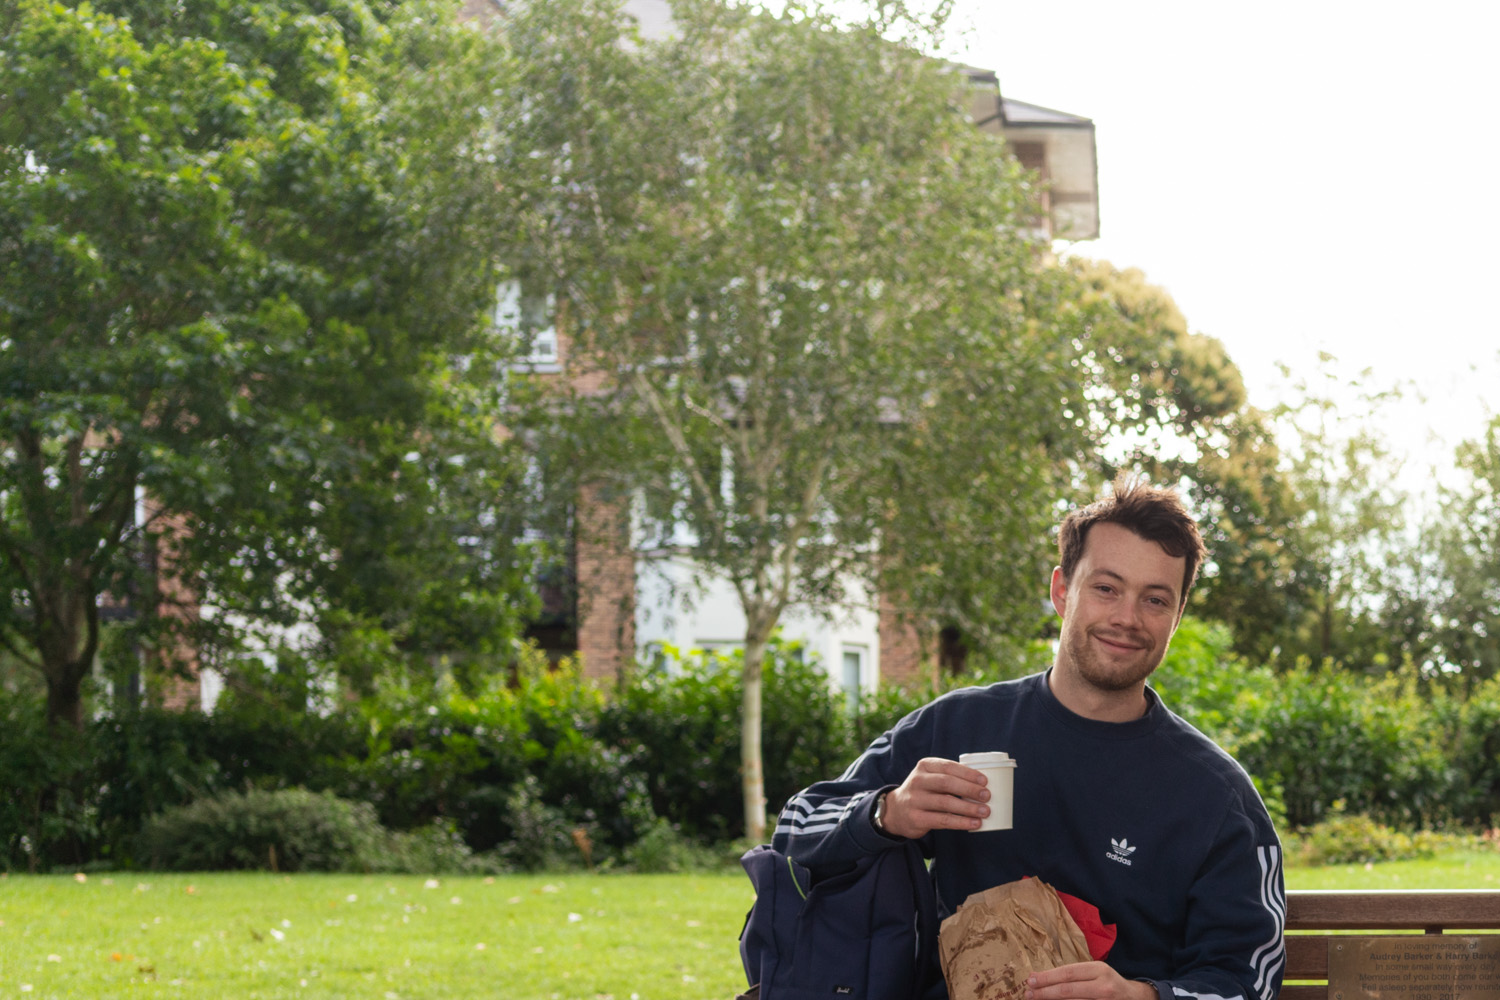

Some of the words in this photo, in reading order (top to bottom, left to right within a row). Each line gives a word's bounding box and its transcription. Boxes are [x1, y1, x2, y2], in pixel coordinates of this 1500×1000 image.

[1105, 852, 1132, 866] adidas
[1404, 943, 1430, 951] loving
[1432, 943, 1466, 951] memory
[1469, 942, 1478, 950] of
[1370, 952, 1401, 961] Audrey
[1404, 952, 1433, 960] Barker
[1436, 952, 1442, 960] &
[1445, 952, 1470, 961] Harry
[1375, 963, 1383, 971] In
[1411, 963, 1434, 971] small
[1436, 964, 1452, 972] way
[1455, 964, 1477, 972] every
[1480, 963, 1496, 972] day
[1359, 973, 1400, 981] Memories
[1403, 973, 1411, 981] of
[1413, 974, 1429, 983] you
[1431, 973, 1450, 981] both
[1361, 983, 1377, 991] Fell
[1379, 983, 1407, 992] asleep
[1439, 993, 1461, 1000] 2017
